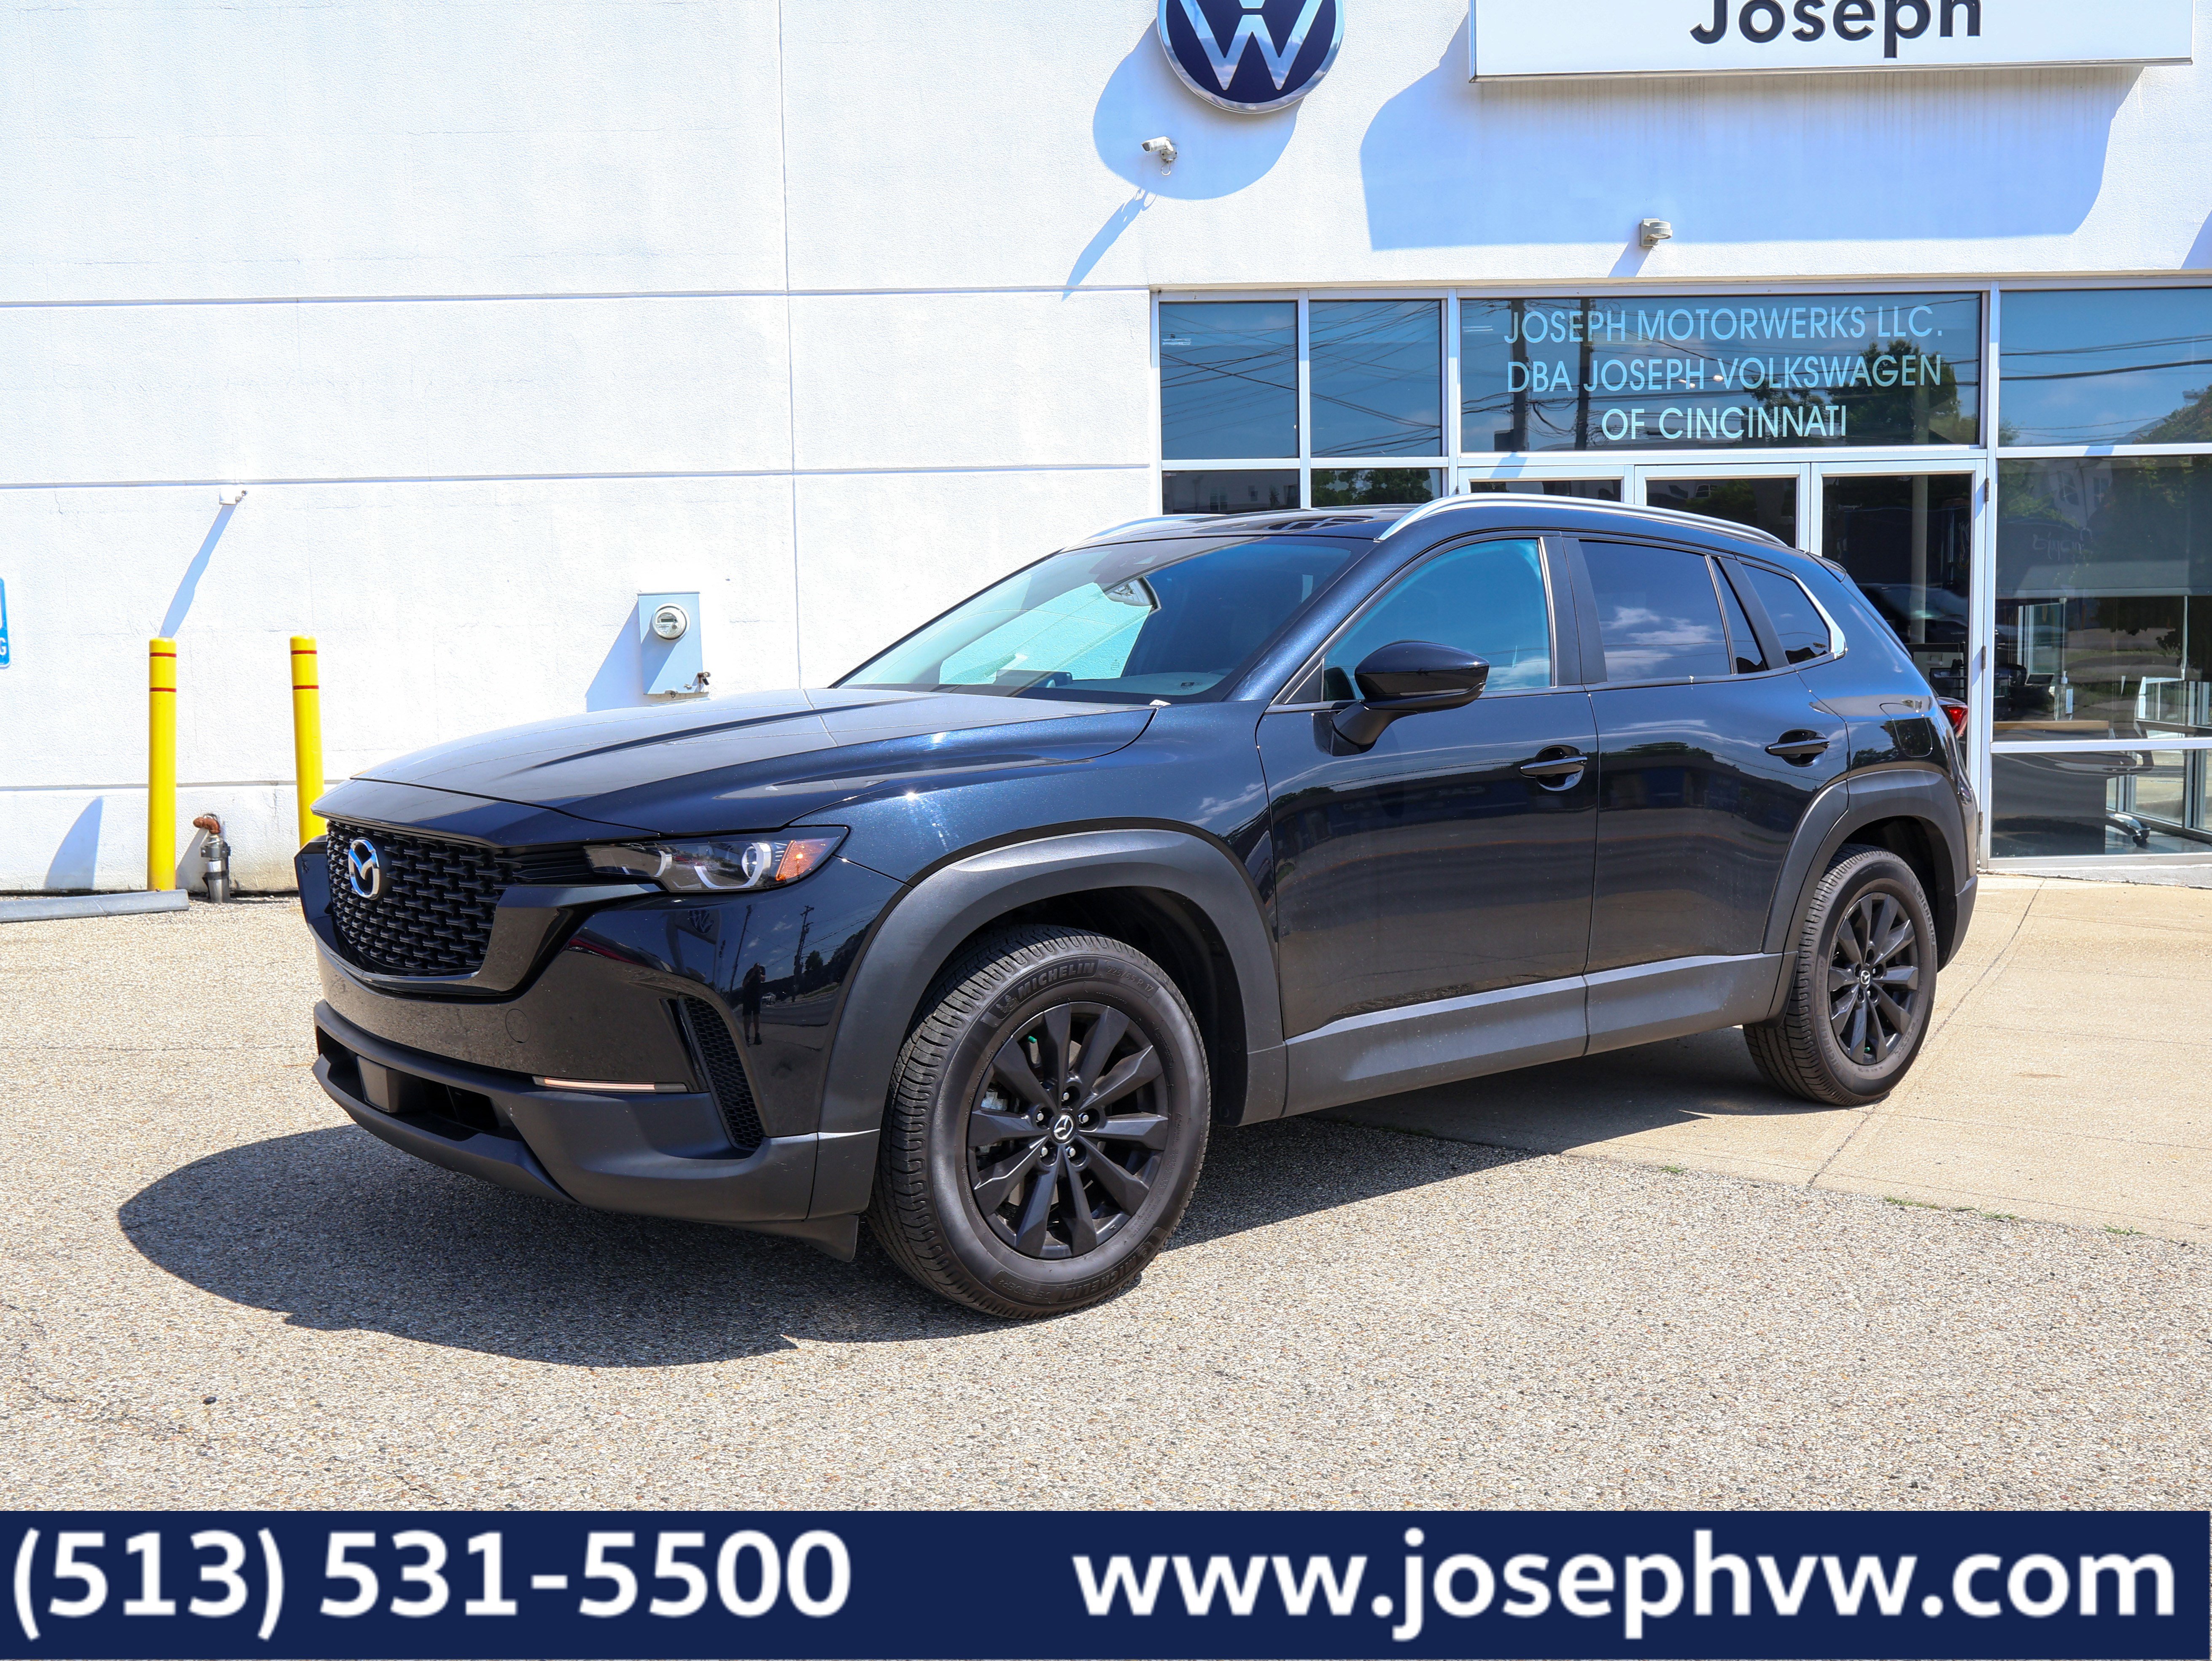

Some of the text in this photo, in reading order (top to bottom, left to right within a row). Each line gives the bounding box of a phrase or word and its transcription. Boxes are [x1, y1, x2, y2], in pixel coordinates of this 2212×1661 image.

[1689, 0, 1981, 58] Joseph
[1504, 305, 1942, 343] JOSEPH MOTORWERKS LLC.
[1508, 355, 1941, 393] DBA JOSEPH VOLKSWAGEN
[1602, 405, 1846, 441] OF CINCINNATI
[1017, 962, 1096, 999] MICHELIN
